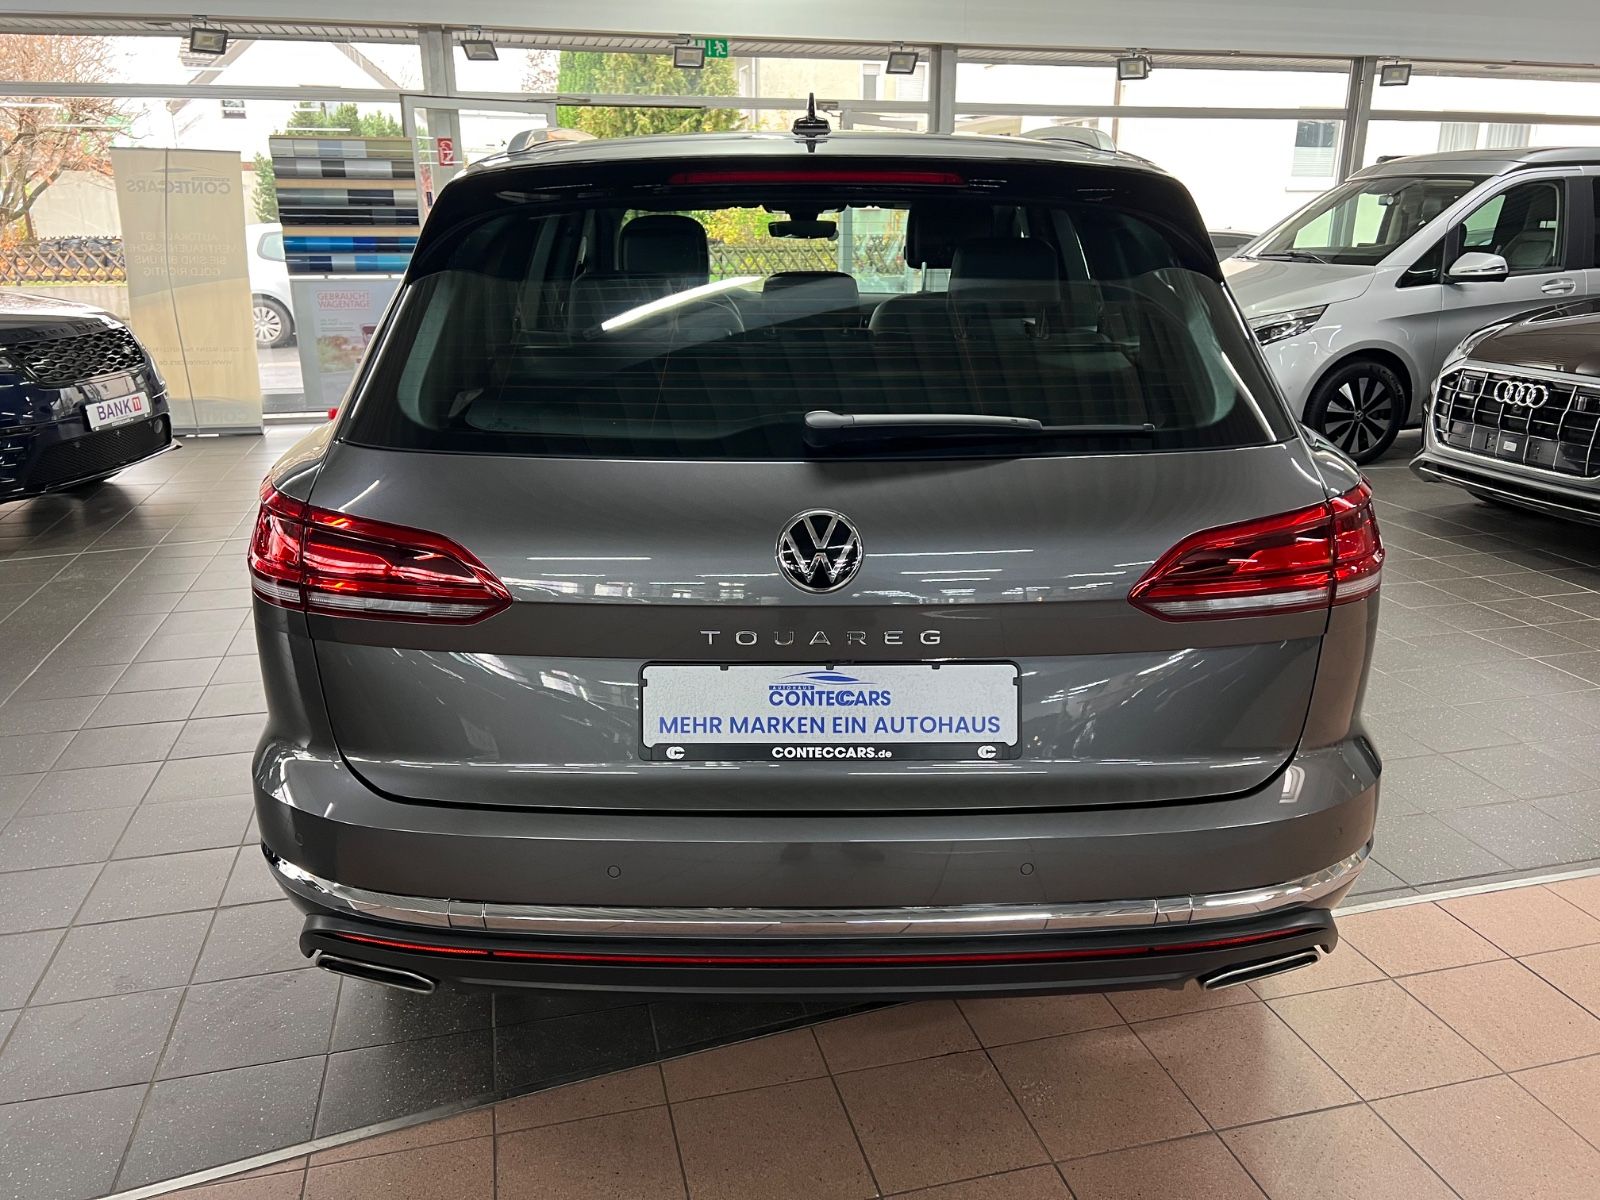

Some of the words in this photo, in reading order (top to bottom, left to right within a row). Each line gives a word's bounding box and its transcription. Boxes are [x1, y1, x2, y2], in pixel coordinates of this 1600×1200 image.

[96, 398, 132, 421] BANK
[700, 630, 942, 646] TOUAREG
[659, 716, 722, 734] MEHR
[729, 716, 827, 734] MARKEN
[832, 716, 867, 734] EIN
[874, 715, 1001, 734] AUTOHAUS
[771, 746, 892, 759] CONTECCARS.de
